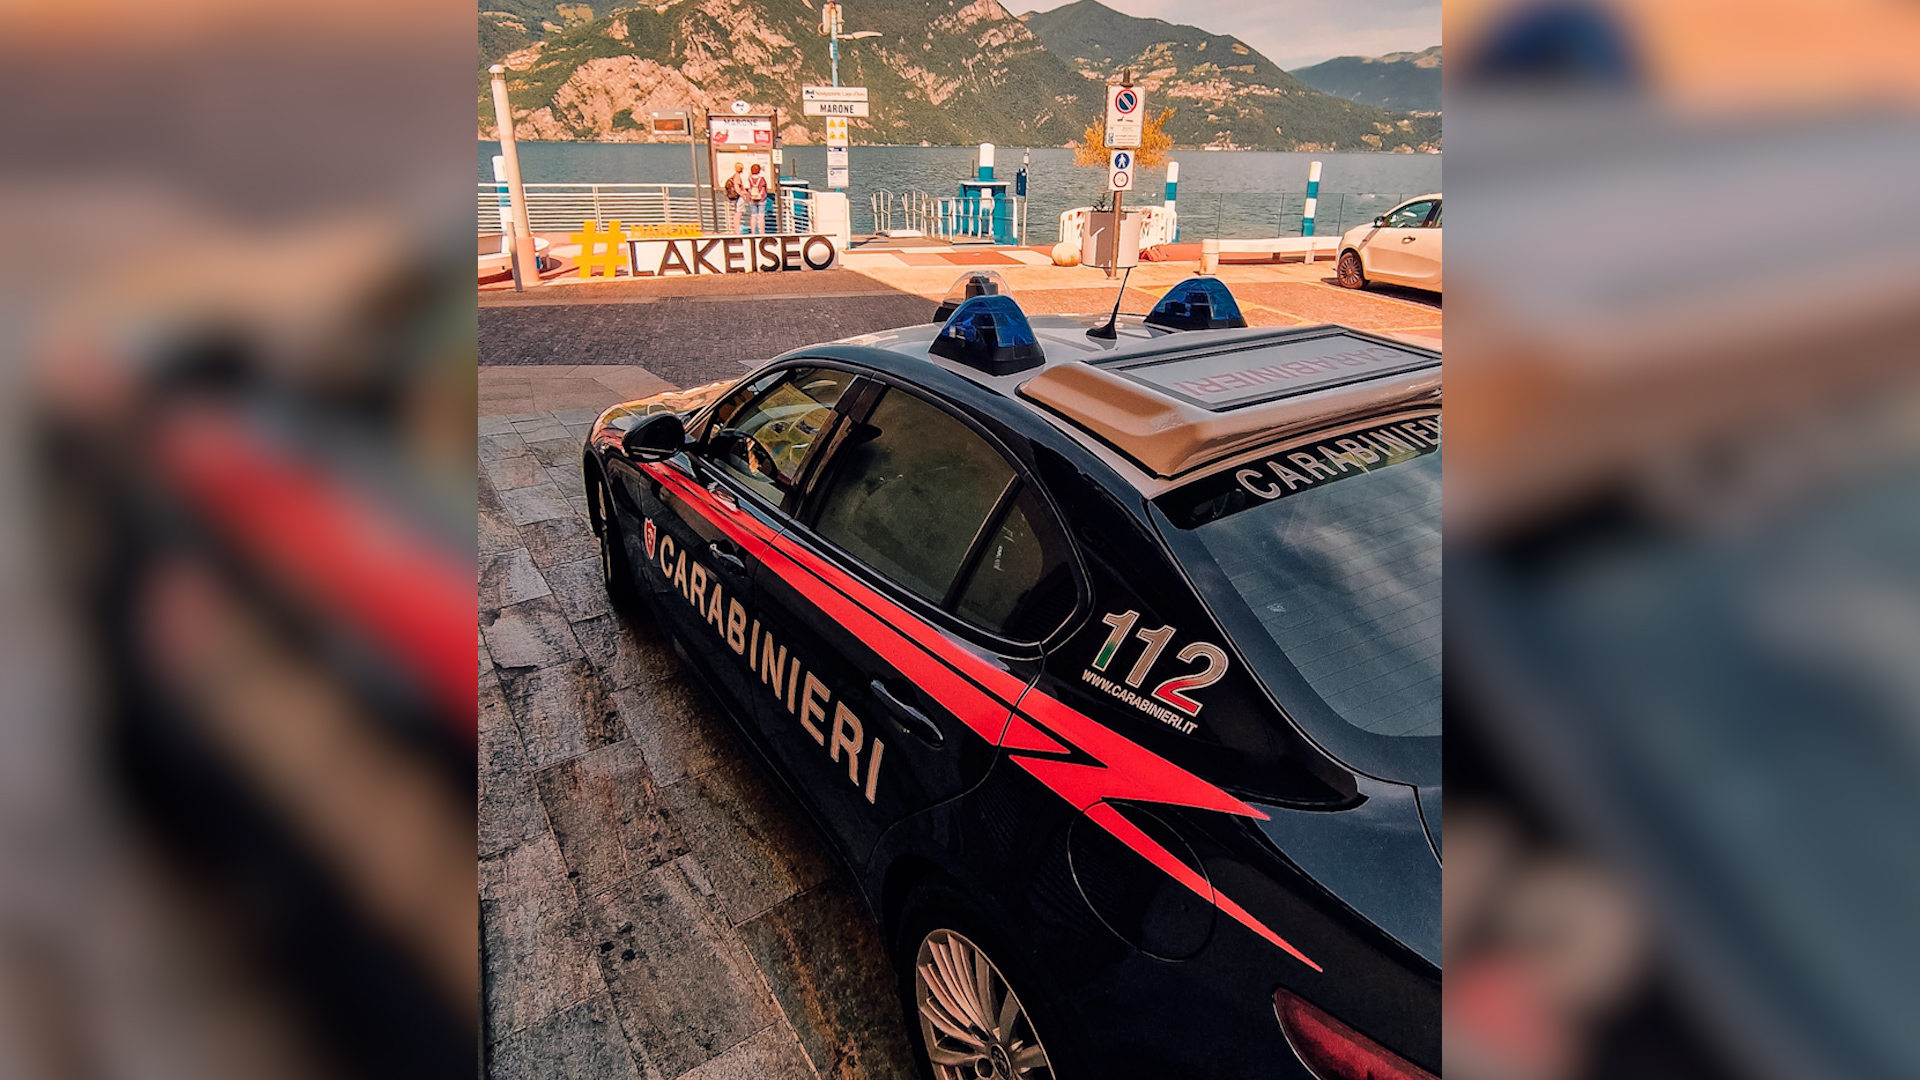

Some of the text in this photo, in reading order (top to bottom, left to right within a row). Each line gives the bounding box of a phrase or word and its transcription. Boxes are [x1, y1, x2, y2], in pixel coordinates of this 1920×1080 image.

[723, 118, 759, 127] MARONE
[820, 104, 854, 114] MARONE
[630, 222, 703, 238] MARONE
[1173, 346, 1404, 396] CARABINIERI
[659, 534, 884, 804] CARABINIERI
[1091, 609, 1230, 718] 112
[1081, 668, 1199, 735] WWW.CARABINIERI.IT
